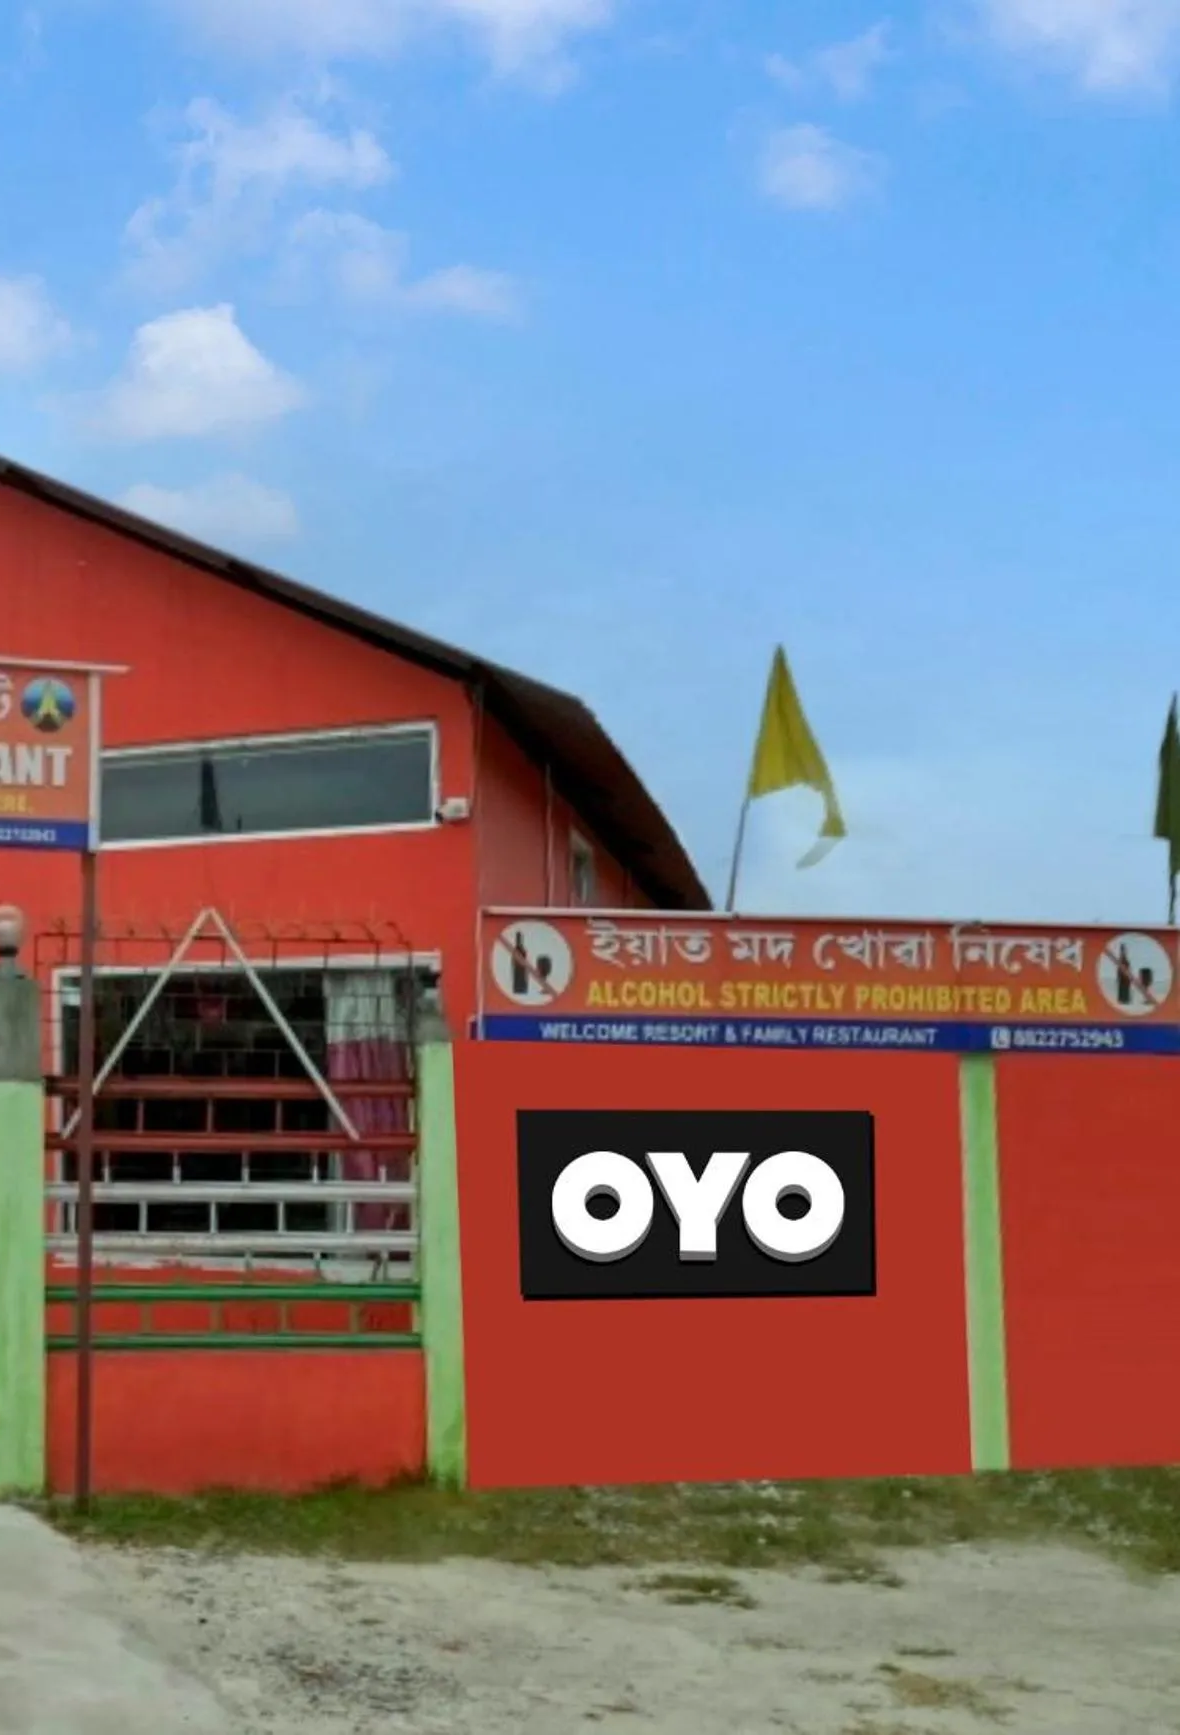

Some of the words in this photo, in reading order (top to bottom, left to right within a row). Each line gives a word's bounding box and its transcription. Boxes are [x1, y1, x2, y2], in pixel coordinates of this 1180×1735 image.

[726, 930, 796, 968] মদ
[950, 922, 1085, 974] নিষেধ
[586, 980, 712, 1008] ALCOHOL
[718, 982, 847, 1010] STRICTLY
[855, 984, 1013, 1014] PROHIBITED
[1019, 987, 1088, 1014] AREA
[539, 1022, 639, 1041] WELCOME
[642, 1023, 718, 1043] RESORT
[724, 1024, 738, 1043] &
[741, 1025, 807, 1044] FAMILY
[812, 1025, 939, 1046] RESTAURANT
[551, 1150, 846, 1263] OYO
